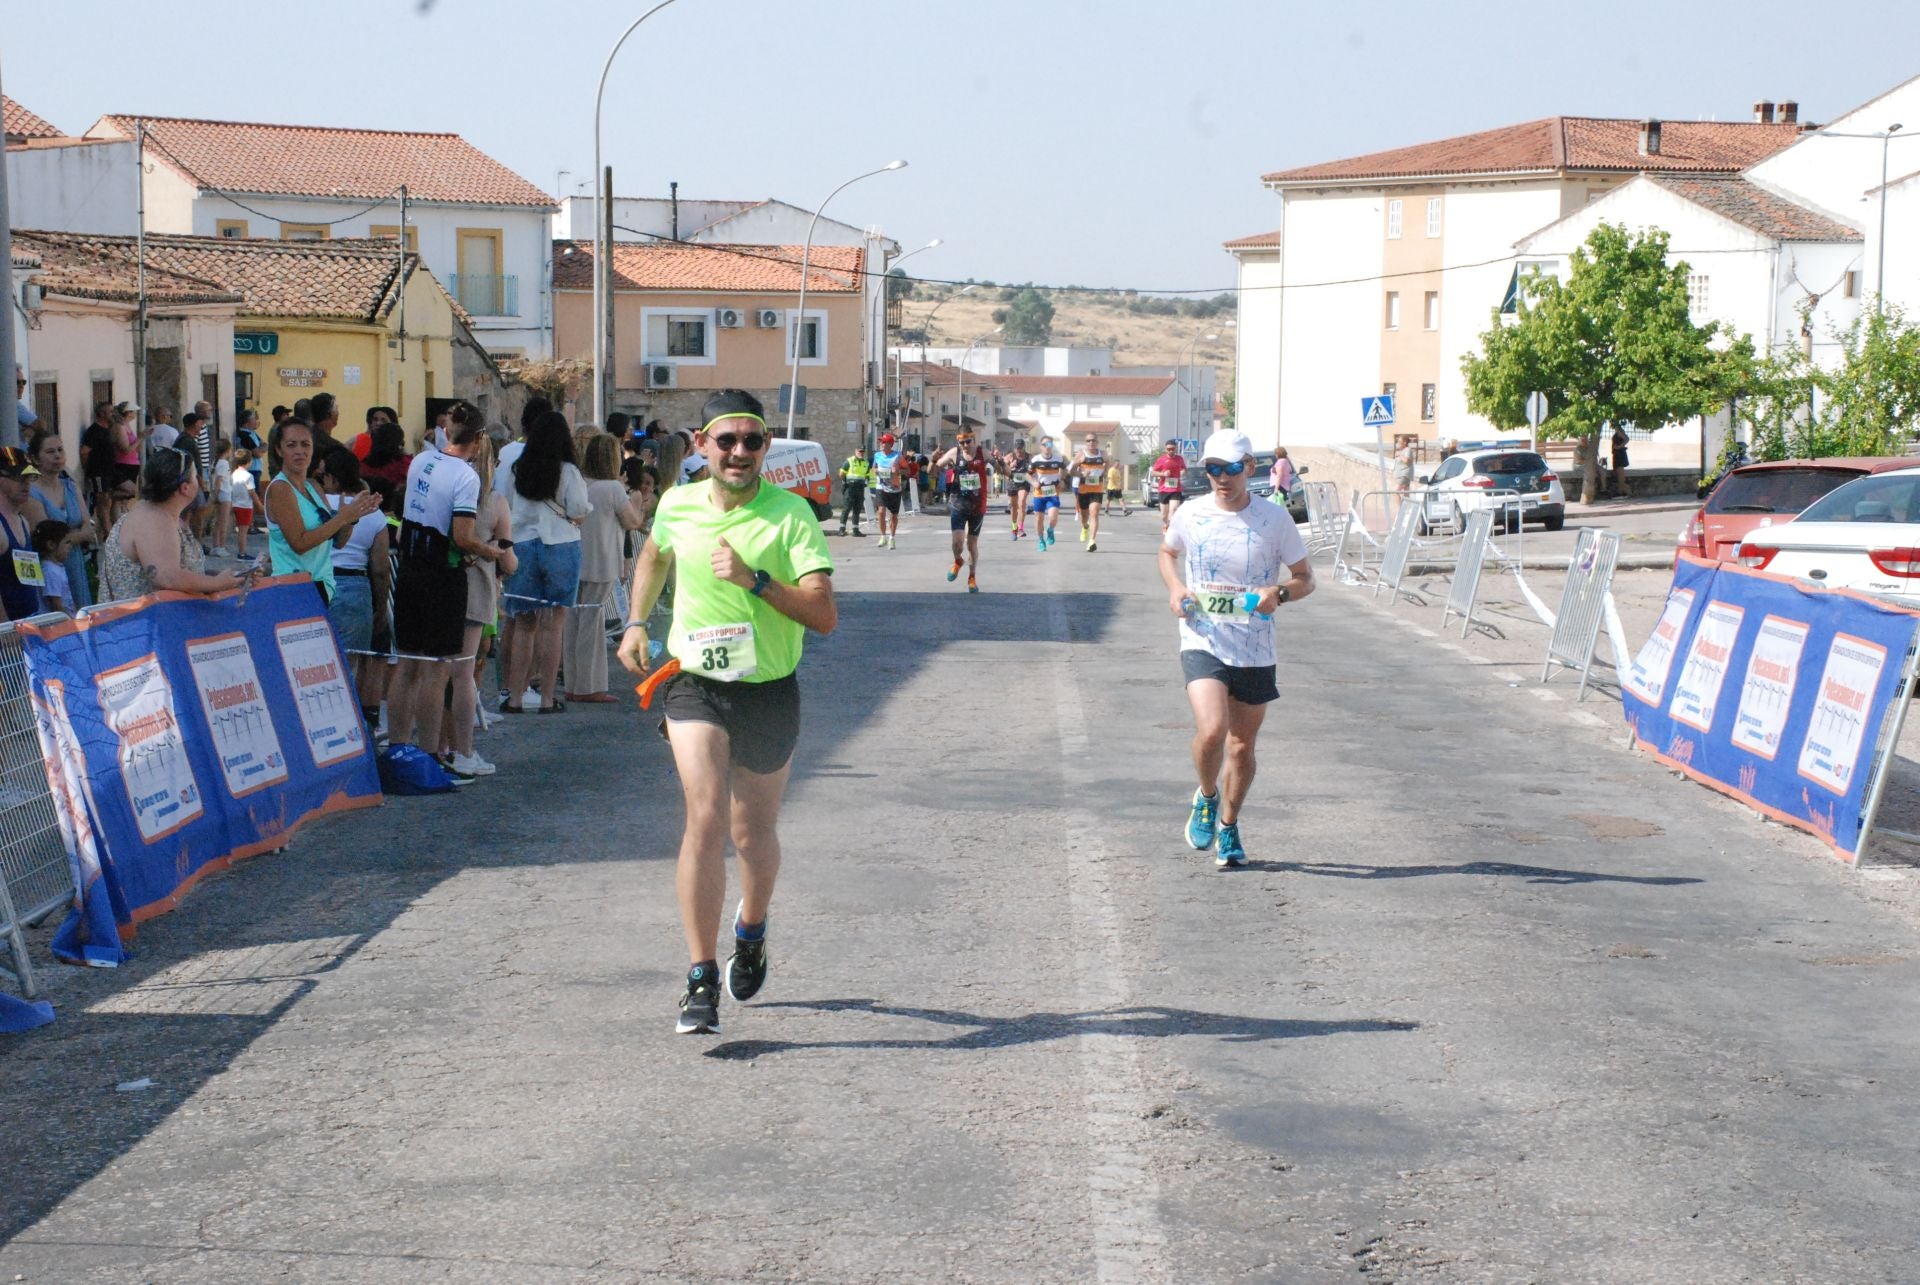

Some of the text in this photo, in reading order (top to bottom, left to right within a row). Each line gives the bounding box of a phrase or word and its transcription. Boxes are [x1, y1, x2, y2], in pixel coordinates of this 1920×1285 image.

[1208, 596, 1234, 614] 221
[715, 626, 747, 637] POPULAR
[702, 646, 730, 671] 33
